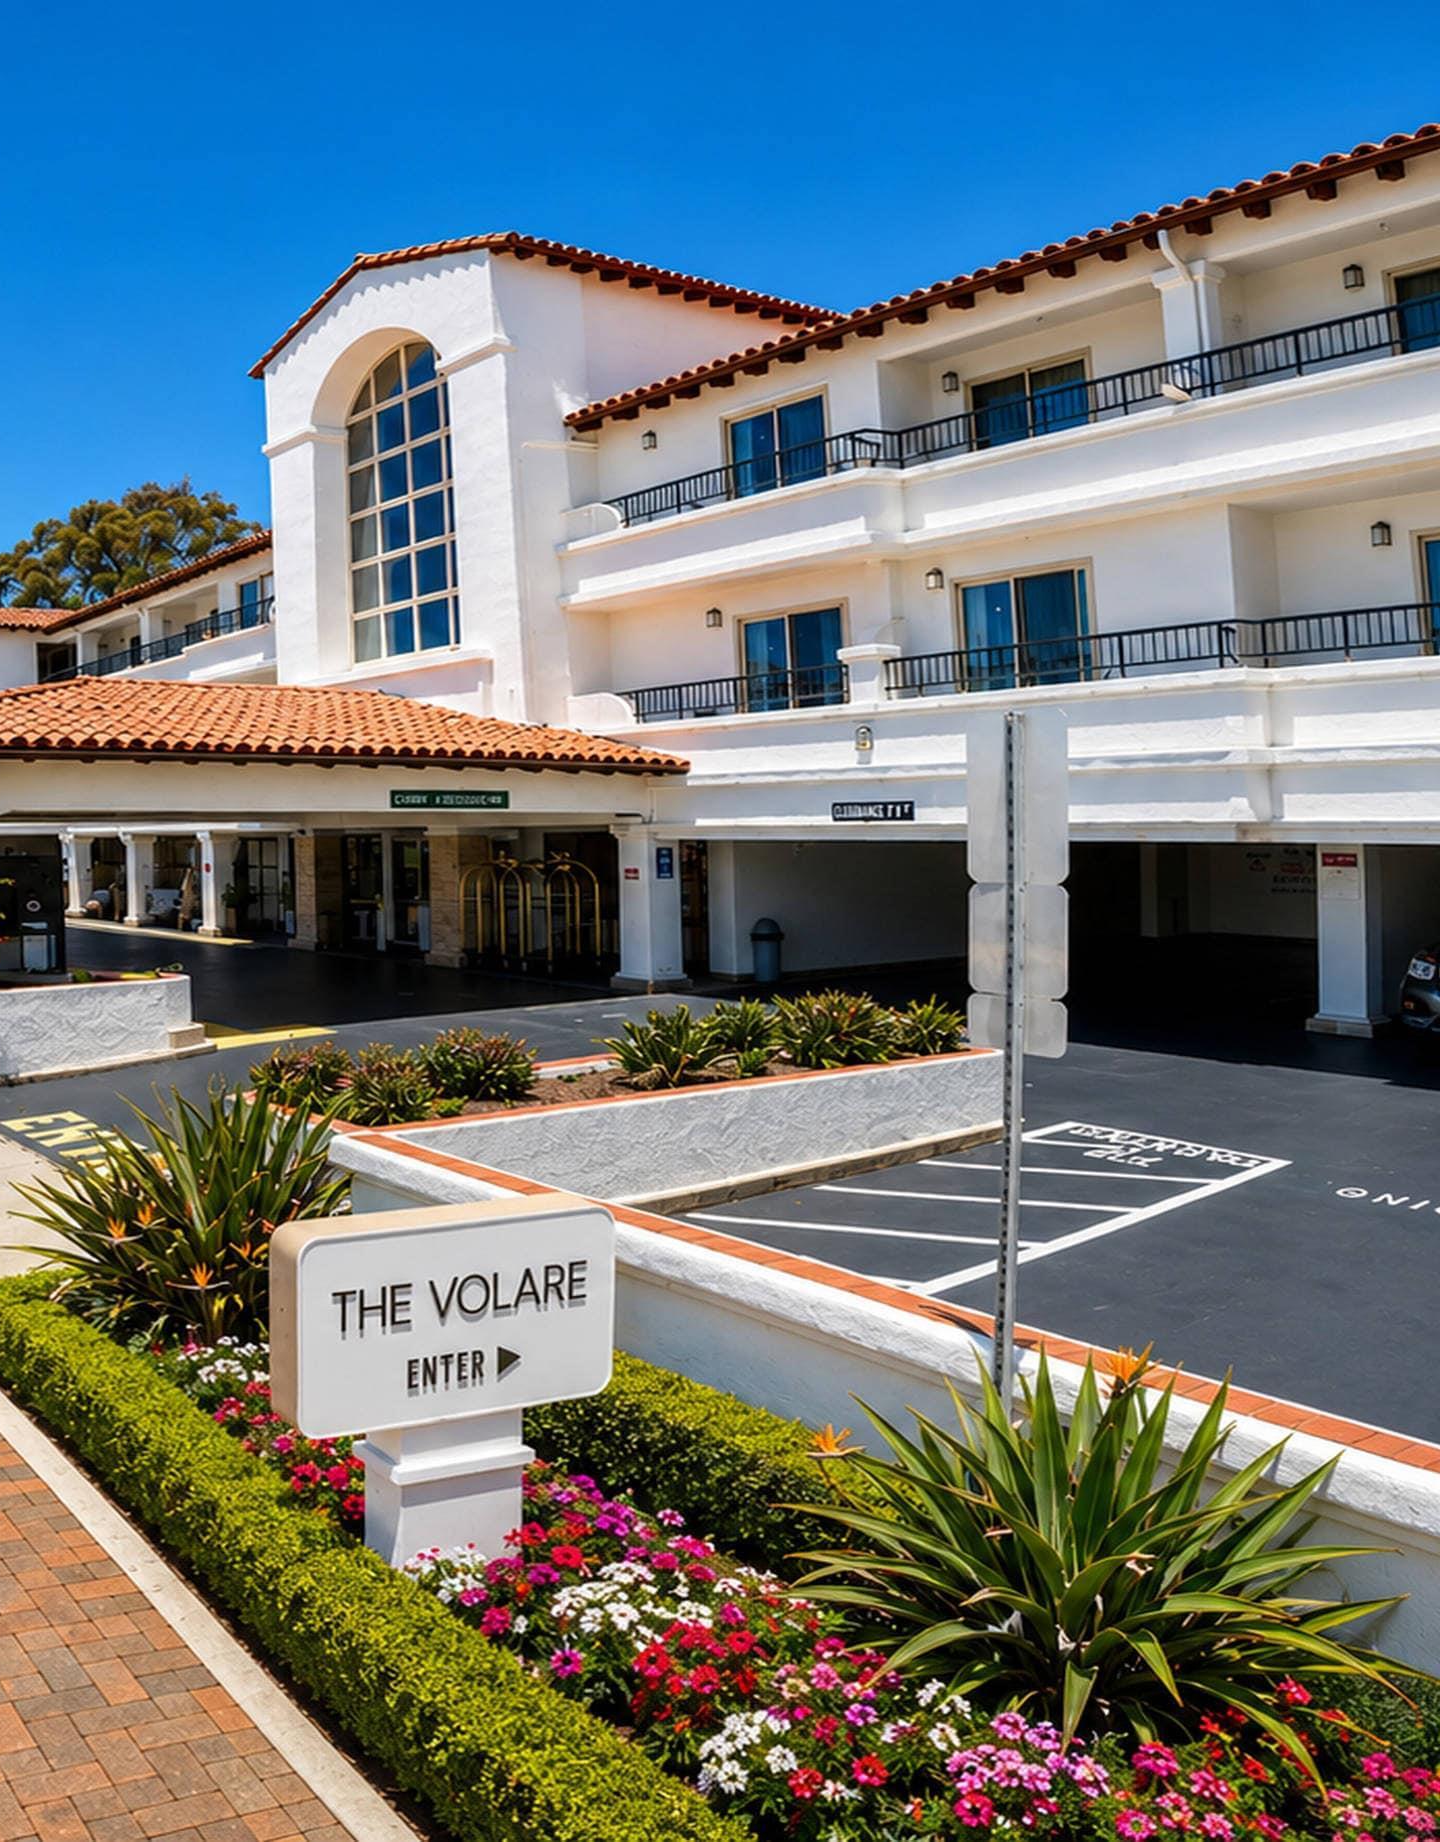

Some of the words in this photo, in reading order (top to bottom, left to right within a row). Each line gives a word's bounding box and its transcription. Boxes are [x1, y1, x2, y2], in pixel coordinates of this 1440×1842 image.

[331, 1282, 413, 1333] THE
[428, 1259, 588, 1319] VOLARE
[407, 1349, 484, 1390] ENTER
